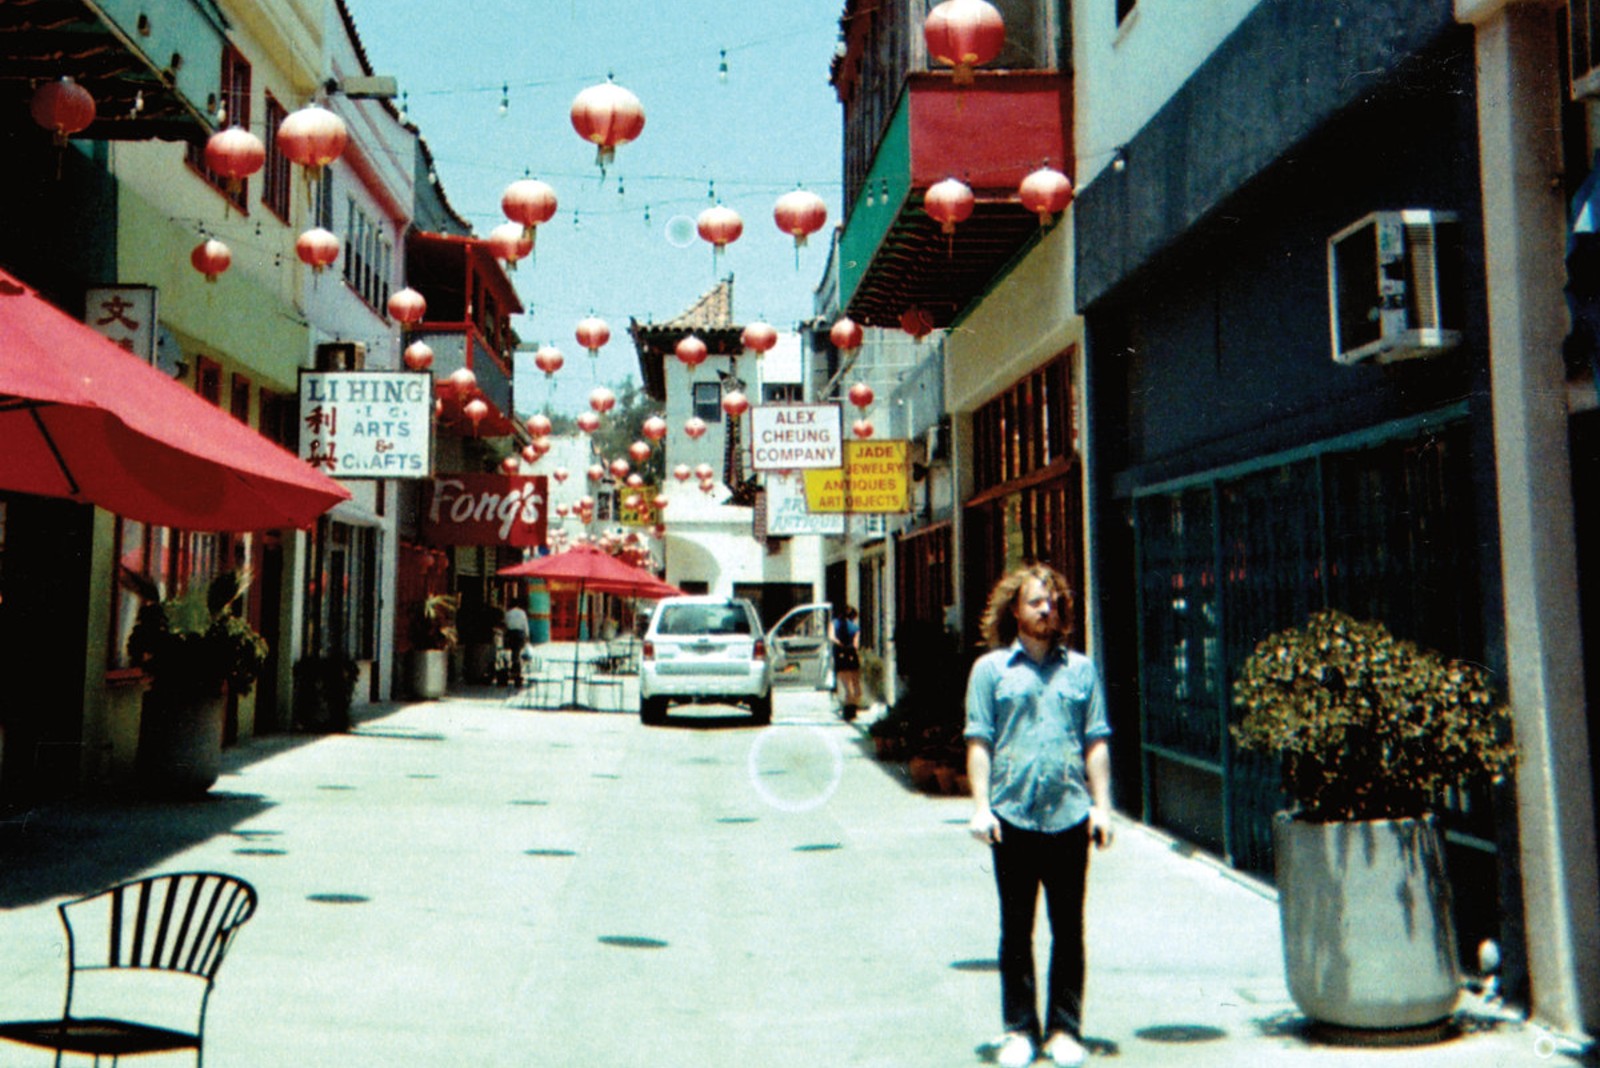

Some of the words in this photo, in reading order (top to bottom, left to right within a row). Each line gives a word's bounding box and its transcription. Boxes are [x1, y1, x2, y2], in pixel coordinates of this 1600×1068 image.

[307, 379, 338, 402] LI
[347, 379, 424, 402] HING
[776, 411, 816, 424] ALEX
[353, 421, 410, 437] ARTS
[762, 429, 830, 443] CHEUNG
[375, 439, 394, 454] &
[856, 446, 894, 458] JADE
[756, 447, 836, 462] COMPANY
[846, 462, 905, 475] JEWELRY
[823, 479, 897, 491] ANTIQUES
[819, 495, 841, 507] ART
[429, 479, 543, 540] Fong's
